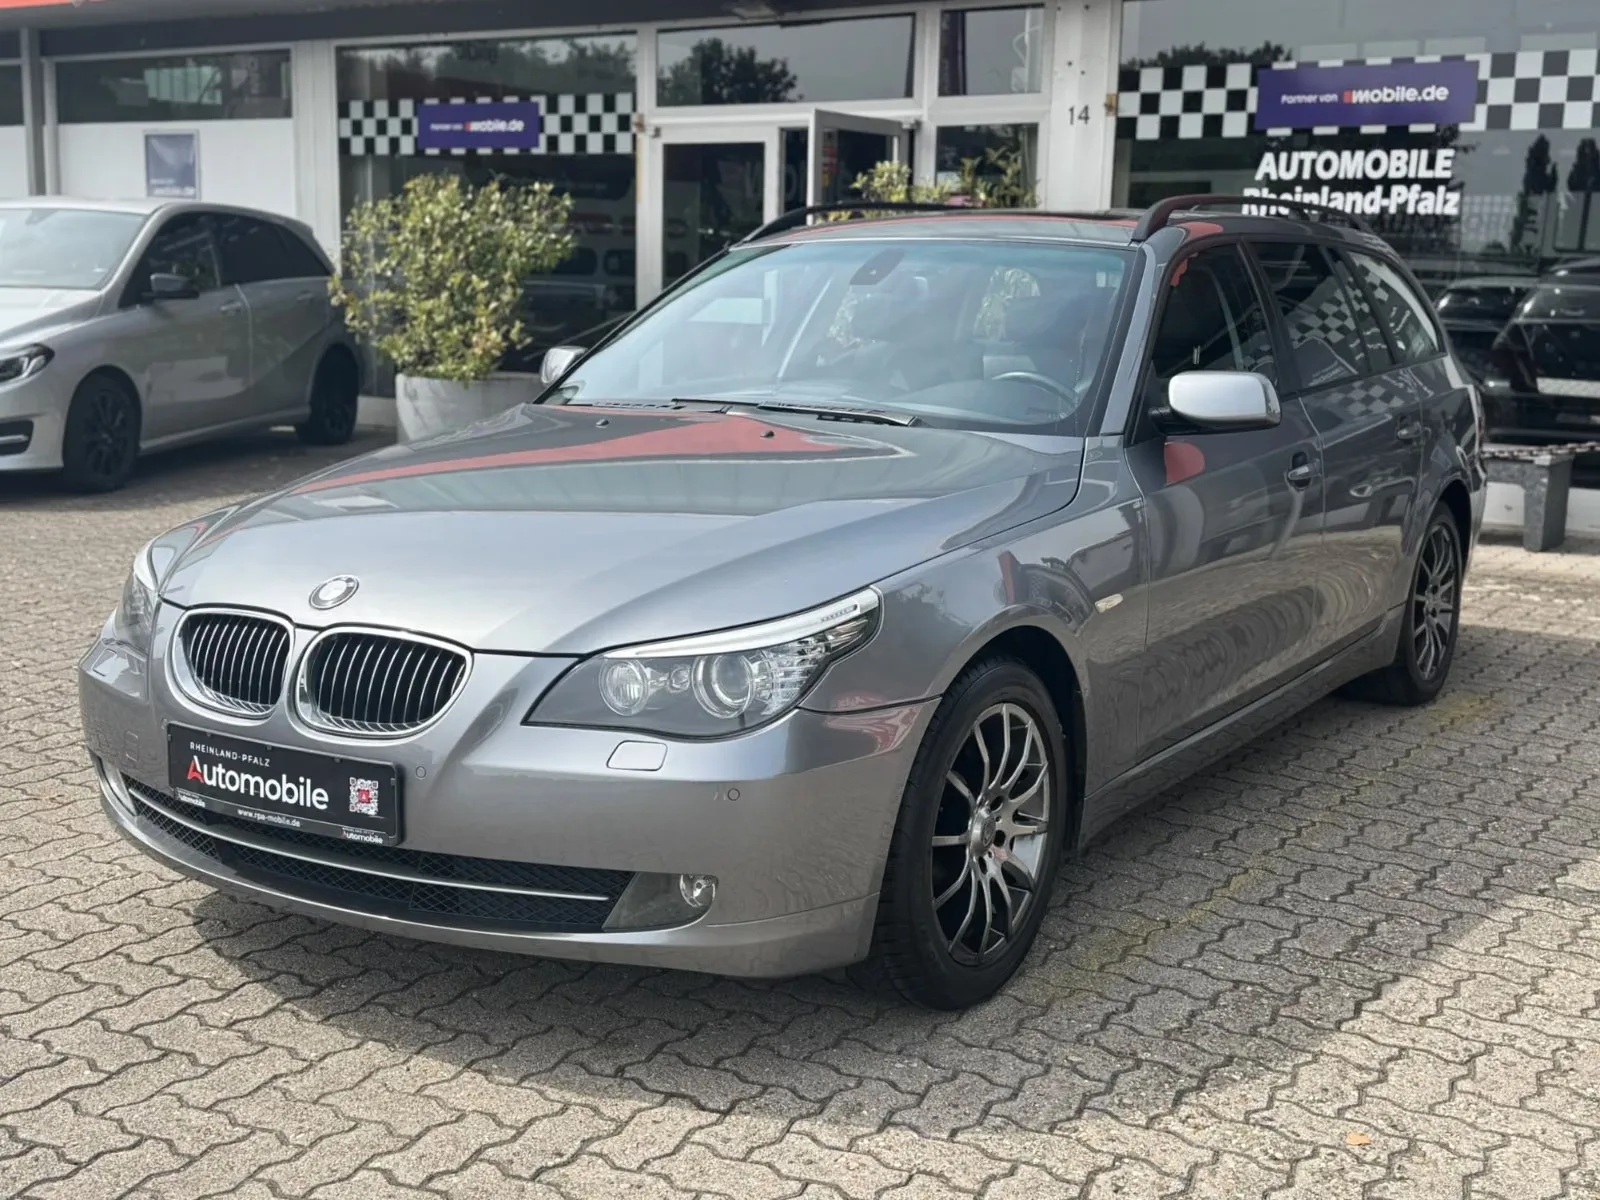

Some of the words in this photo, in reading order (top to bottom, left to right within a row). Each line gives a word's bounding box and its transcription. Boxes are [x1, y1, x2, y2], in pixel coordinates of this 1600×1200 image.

[1280, 93, 1318, 105] Partner
[1319, 93, 1339, 103] von
[1344, 85, 1449, 104] mobile.de
[1068, 104, 1091, 125] 14
[1254, 148, 1455, 181] AUTOMOBILE
[189, 741, 271, 768] RHEINLAND-PFALZ
[187, 755, 329, 810] Automobile
